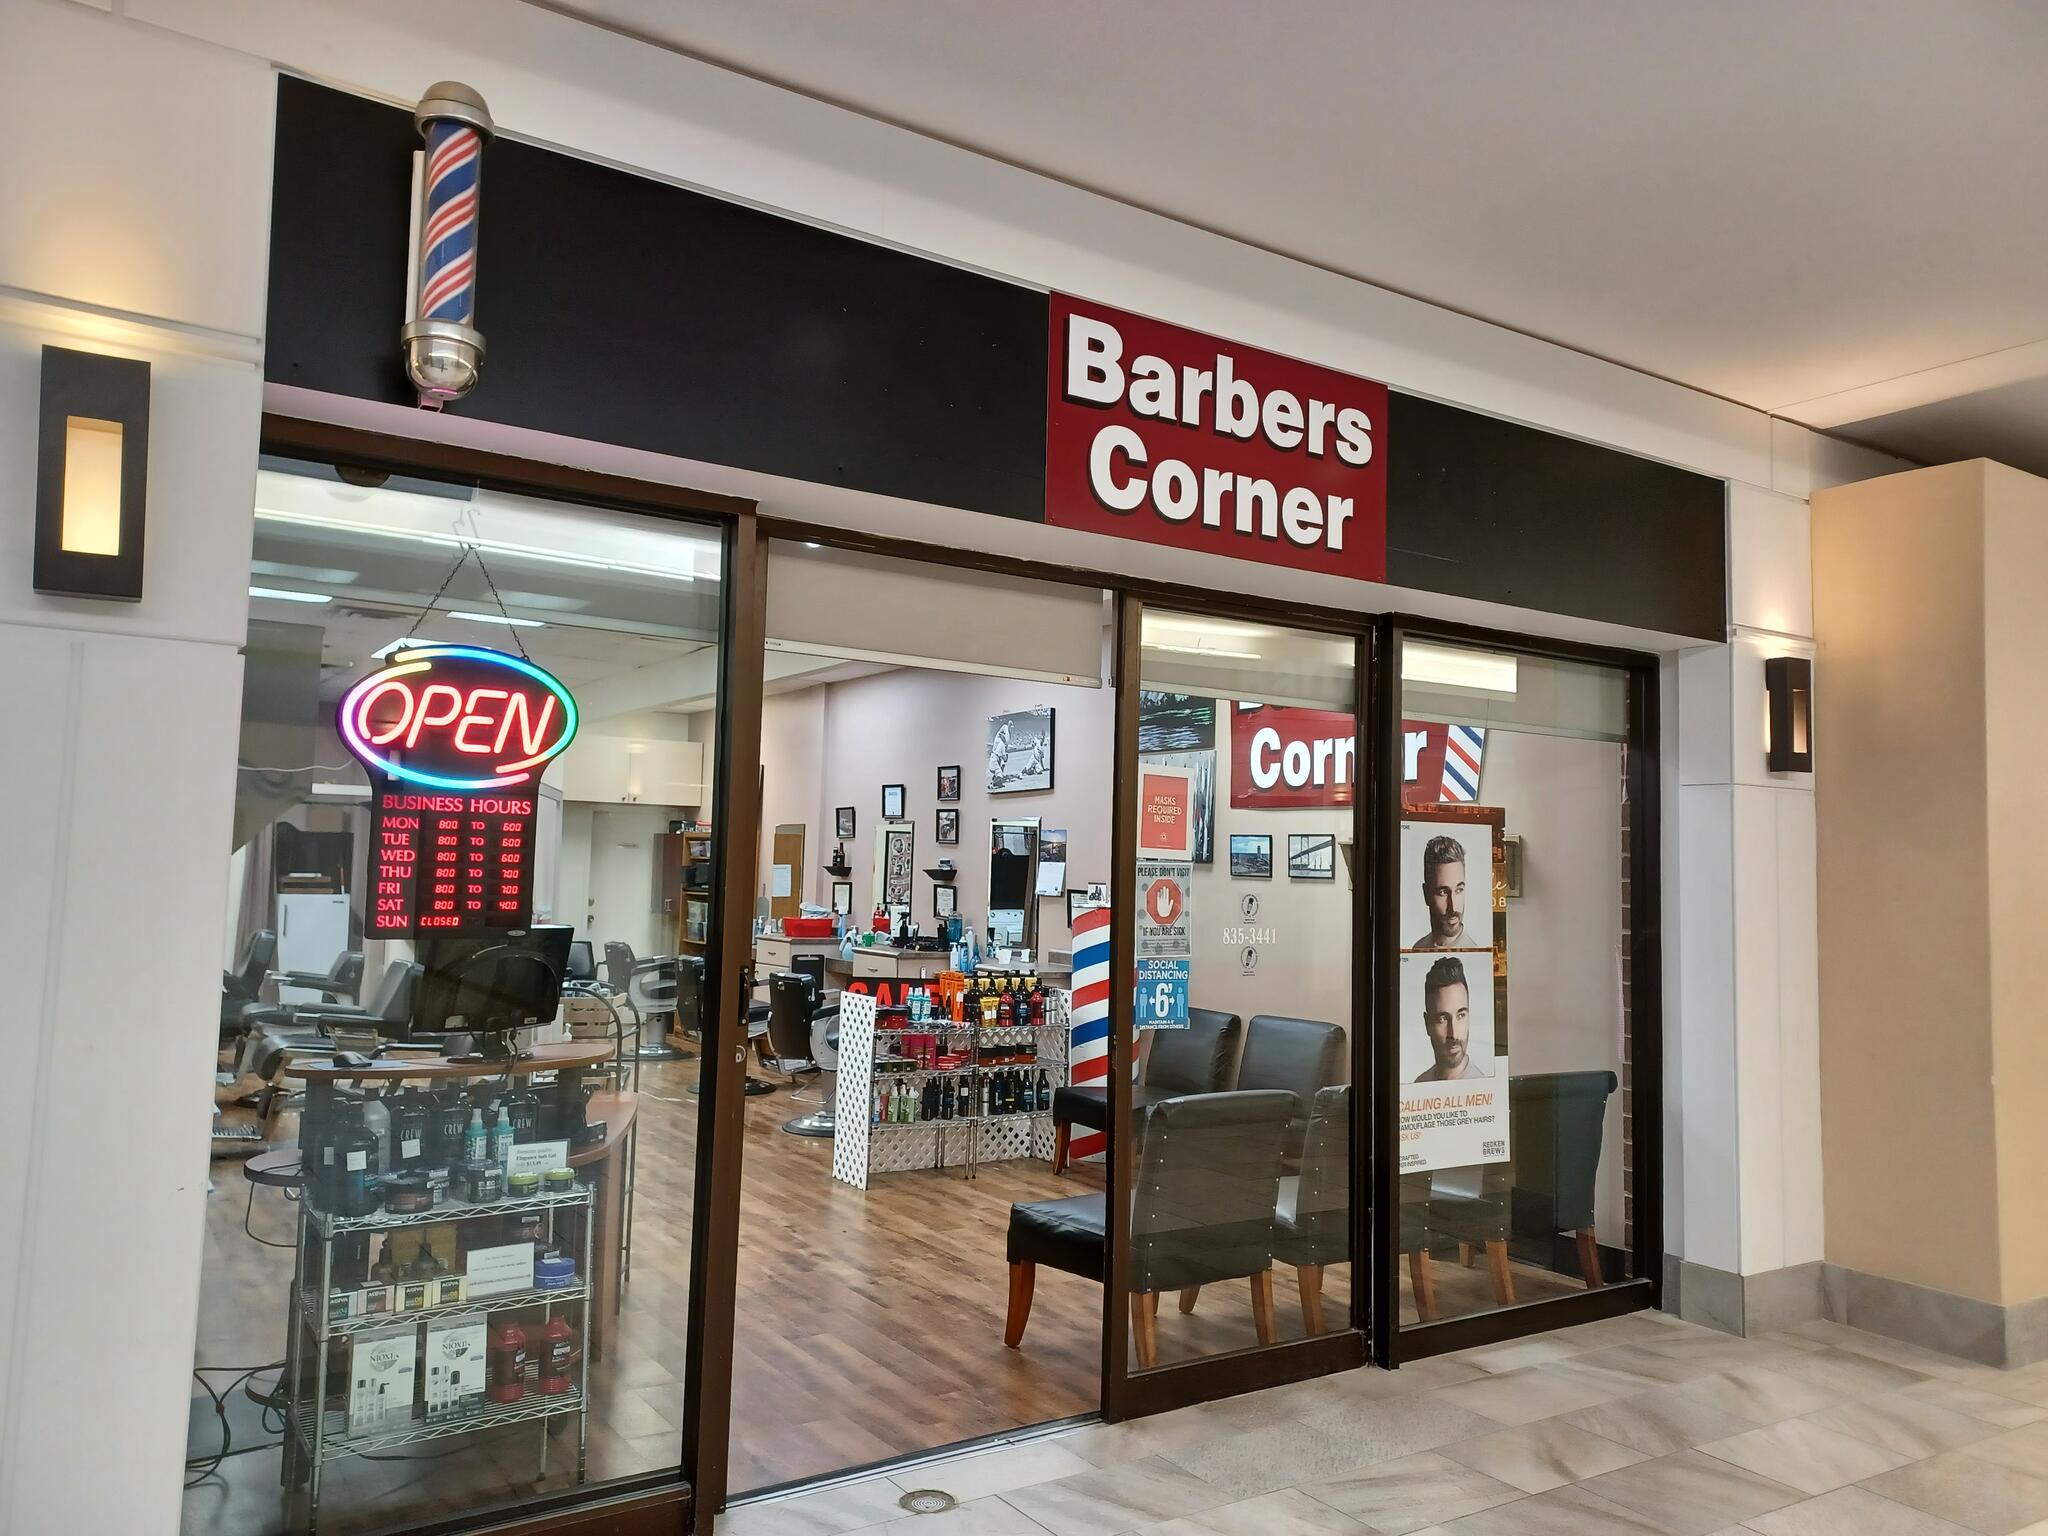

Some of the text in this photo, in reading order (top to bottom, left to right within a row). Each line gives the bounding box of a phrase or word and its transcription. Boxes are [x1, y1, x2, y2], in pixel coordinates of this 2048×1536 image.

[1066, 313, 1373, 466] Barbers
[1089, 425, 1354, 550] Corner
[357, 681, 556, 756] OPEN
[1251, 727, 1428, 789] Cornr
[382, 795, 531, 815] BUSINESS HOURS
[1155, 796, 1177, 806] MASKS
[1147, 804, 1182, 816] REQUIRED
[382, 816, 419, 830] MON
[471, 821, 486, 831] TO
[1153, 814, 1176, 824] INSIDE
[382, 832, 410, 846] TUE
[470, 837, 485, 846] TO
[381, 849, 416, 862] WED
[469, 853, 484, 862] TO
[380, 865, 412, 878] THU
[468, 869, 483, 878] TO
[1137, 867, 1159, 877] PLEASE
[378, 882, 401, 895] FRI
[468, 885, 482, 894] TO
[377, 899, 404, 911] SAT
[467, 901, 481, 910] TO
[376, 915, 460, 928] SUN CLOSED
[1143, 926, 1186, 936] IF YOU ARE SICK
[1223, 927, 1276, 945] 835-3441
[1148, 960, 1179, 969] SOCIAL
[1139, 970, 1188, 980] DISTANCING
[1155, 983, 1173, 1018] 6'
[1443, 1095, 1463, 1109] ALL
[1465, 1093, 1493, 1107] MEN!
[1400, 1115, 1410, 1124] OW
[1411, 1113, 1432, 1122] WOULD
[1433, 1112, 1445, 1120] YOU
[1446, 1110, 1458, 1118] LIKE
[1400, 1115, 1495, 1131] AMOUFLAGE THOSE GREY HAIRS?
[444, 1121, 464, 1135] CREW
[513, 1118, 532, 1130] CREW
[1400, 1133, 1409, 1141] SK
[1483, 1147, 1505, 1155] BREWS
